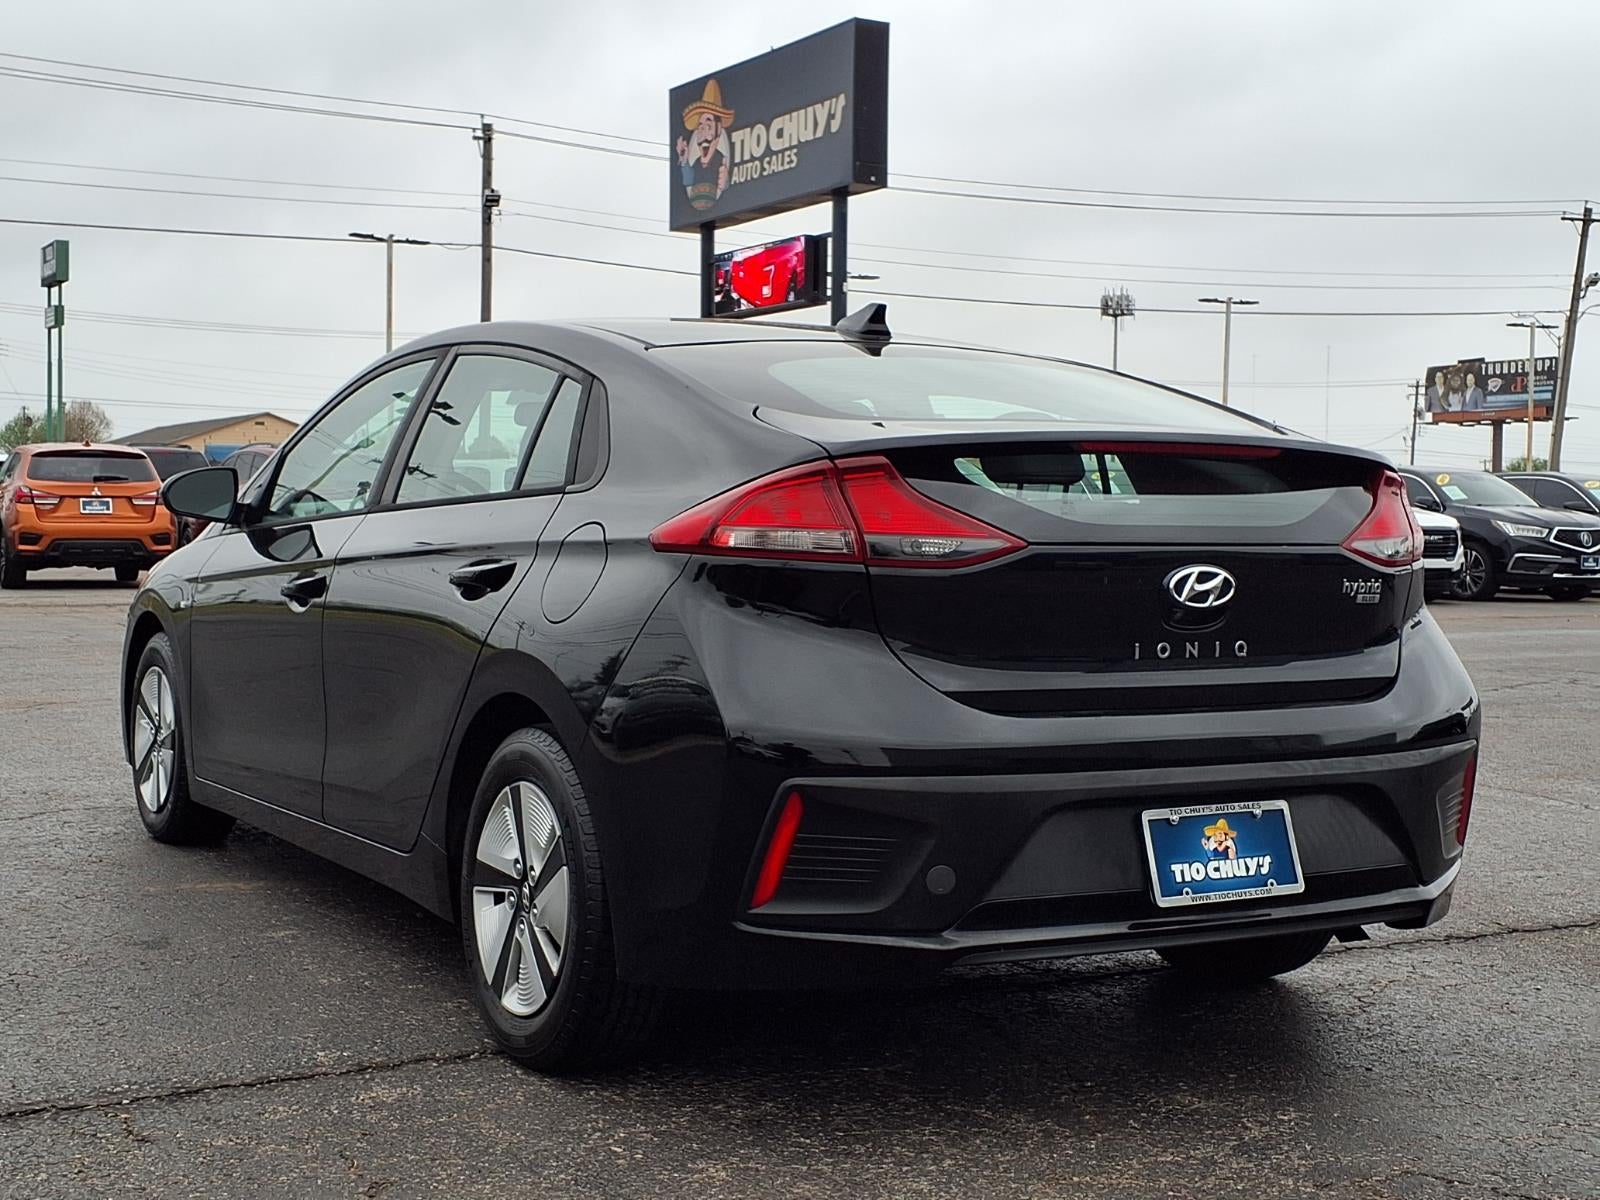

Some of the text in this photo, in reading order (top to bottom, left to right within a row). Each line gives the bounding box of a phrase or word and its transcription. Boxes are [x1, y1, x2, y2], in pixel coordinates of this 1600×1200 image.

[731, 93, 846, 163] TIO CHUY'S
[731, 148, 798, 184] AUTO SALES
[1481, 358, 1556, 375] THUNDER UP!
[1342, 578, 1382, 596] hybrid
[1184, 806, 1213, 815] CHUY'S
[1215, 804, 1236, 813] AUTO
[1237, 802, 1262, 811] SALES
[1170, 855, 1272, 883] TIO CHUY'S
[1190, 888, 1273, 903] WWW.TIOCHUYS.COM
